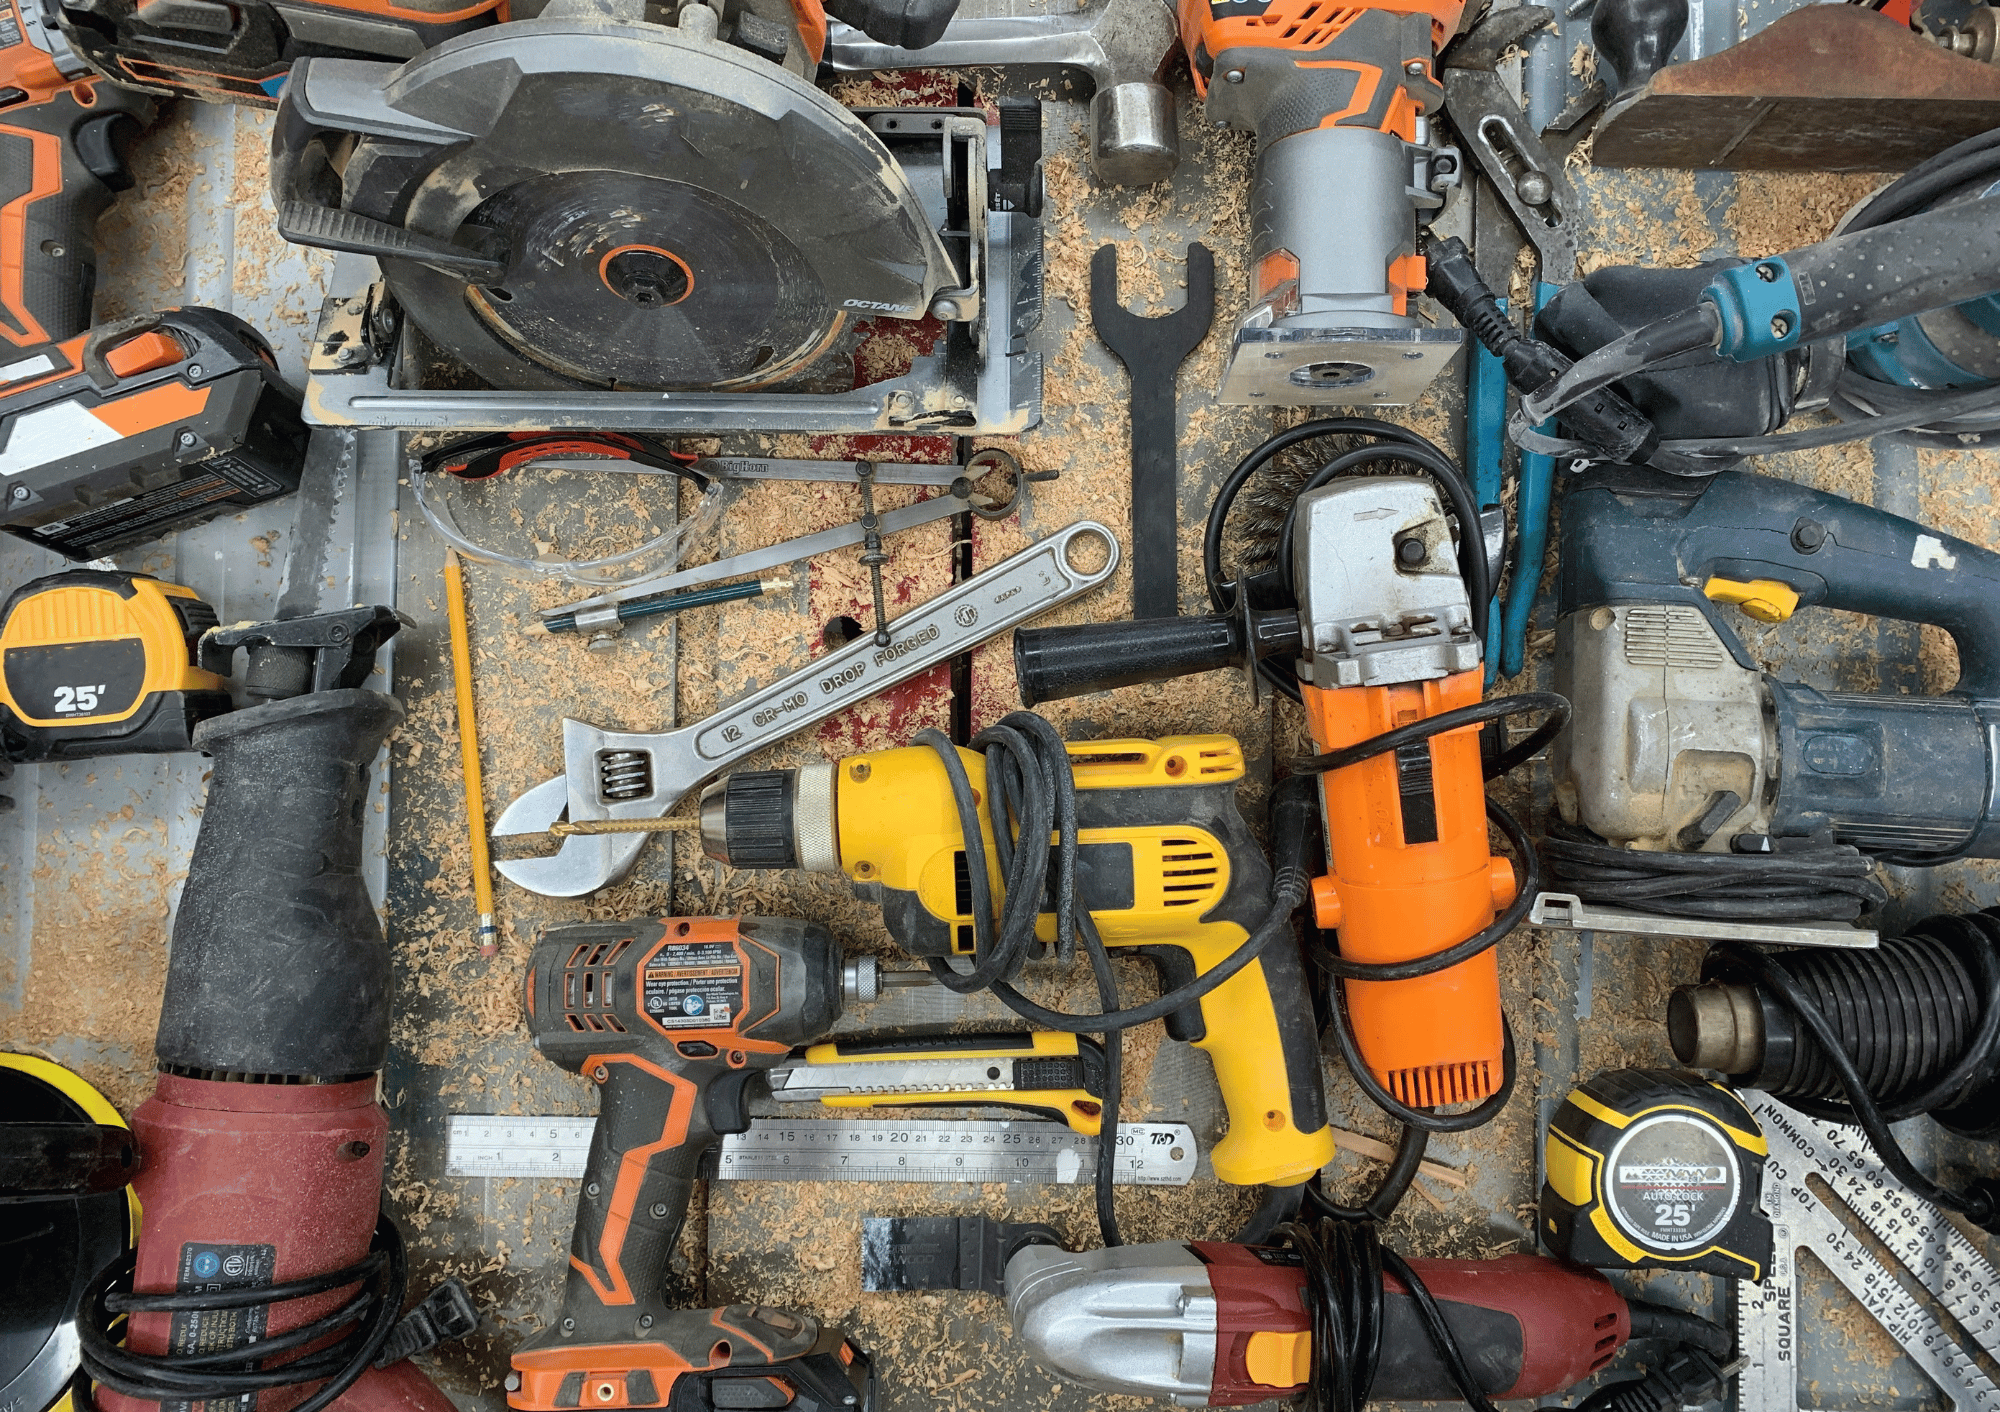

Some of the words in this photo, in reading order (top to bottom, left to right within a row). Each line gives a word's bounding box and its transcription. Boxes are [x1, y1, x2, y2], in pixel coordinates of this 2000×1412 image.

[843, 298, 916, 312] OCTANE
[720, 460, 768, 474] BigHorn
[722, 725, 743, 742] 12
[752, 691, 808, 726] CR-MO
[819, 661, 866, 694] DROP
[874, 622, 940, 667] FORGED
[54, 684, 106, 712] 25'
[550, 1129, 557, 1138] 5
[780, 1132, 795, 1141] 15
[890, 1133, 908, 1142] 20
[1003, 1134, 1021, 1143] 25
[1116, 1136, 1134, 1145] 30
[1764, 1104, 1814, 1158] COMMON
[1827, 1130, 1846, 1149] 70
[496, 1152, 500, 1160] 1
[552, 1153, 559, 1161] 2
[725, 1155, 732, 1164] 5
[783, 1156, 789, 1164] 6
[841, 1156, 848, 1164] 7
[898, 1157, 904, 1166] 8
[956, 1157, 962, 1166] 9
[1015, 1158, 1028, 1167] 10
[1130, 1160, 1144, 1169] 12
[1829, 1157, 1848, 1178] 30
[1846, 1150, 1865, 1169] 65
[1847, 1176, 1867, 1196] 24
[1866, 1170, 1884, 1188] 60
[1791, 1187, 1816, 1212] TOP
[1883, 1189, 1902, 1209] 55
[1655, 1204, 1696, 1226] 25'
[1870, 1201, 1886, 1217] 18
[1901, 1208, 1920, 1227] 50
[1886, 1218, 1902, 1234] 15
[1918, 1226, 1936, 1243] 45
[1651, 1232, 1670, 1241] MADE
[1679, 1233, 1693, 1241] USA
[1826, 1233, 1845, 1252] 30
[1907, 1238, 1922, 1256] 12
[1936, 1244, 1953, 1261] 40
[1844, 1251, 1863, 1270] 24
[1924, 1257, 1940, 1274] 10
[1764, 1243, 1776, 1302] SPE
[1952, 1262, 1972, 1282] 35
[1865, 1273, 1880, 1289] 18
[1944, 1279, 1956, 1290] 8
[1878, 1288, 1894, 1303] 15
[1956, 1294, 1968, 1304] 7
[1971, 1282, 1990, 1302] 30
[1752, 1300, 1764, 1310] 2
[1894, 1303, 1909, 1320] 12
[1970, 1305, 1980, 1316] 6
[1778, 1286, 1790, 1362] SQUARE
[1862, 1288, 1912, 1344] HIP-VAL
[200, 1316, 209, 1347] REDUCE
[1908, 1319, 1923, 1334] 10
[1982, 1319, 1994, 1331] 5
[209, 1328, 216, 1340] OF
[1924, 1336, 1934, 1346] 8
[1931, 1347, 1943, 1357] 7
[1943, 1357, 1953, 1367] 6
[1953, 1367, 1964, 1378] 5
[1965, 1378, 1974, 1388] 4
[1975, 1391, 1986, 1402] 3
